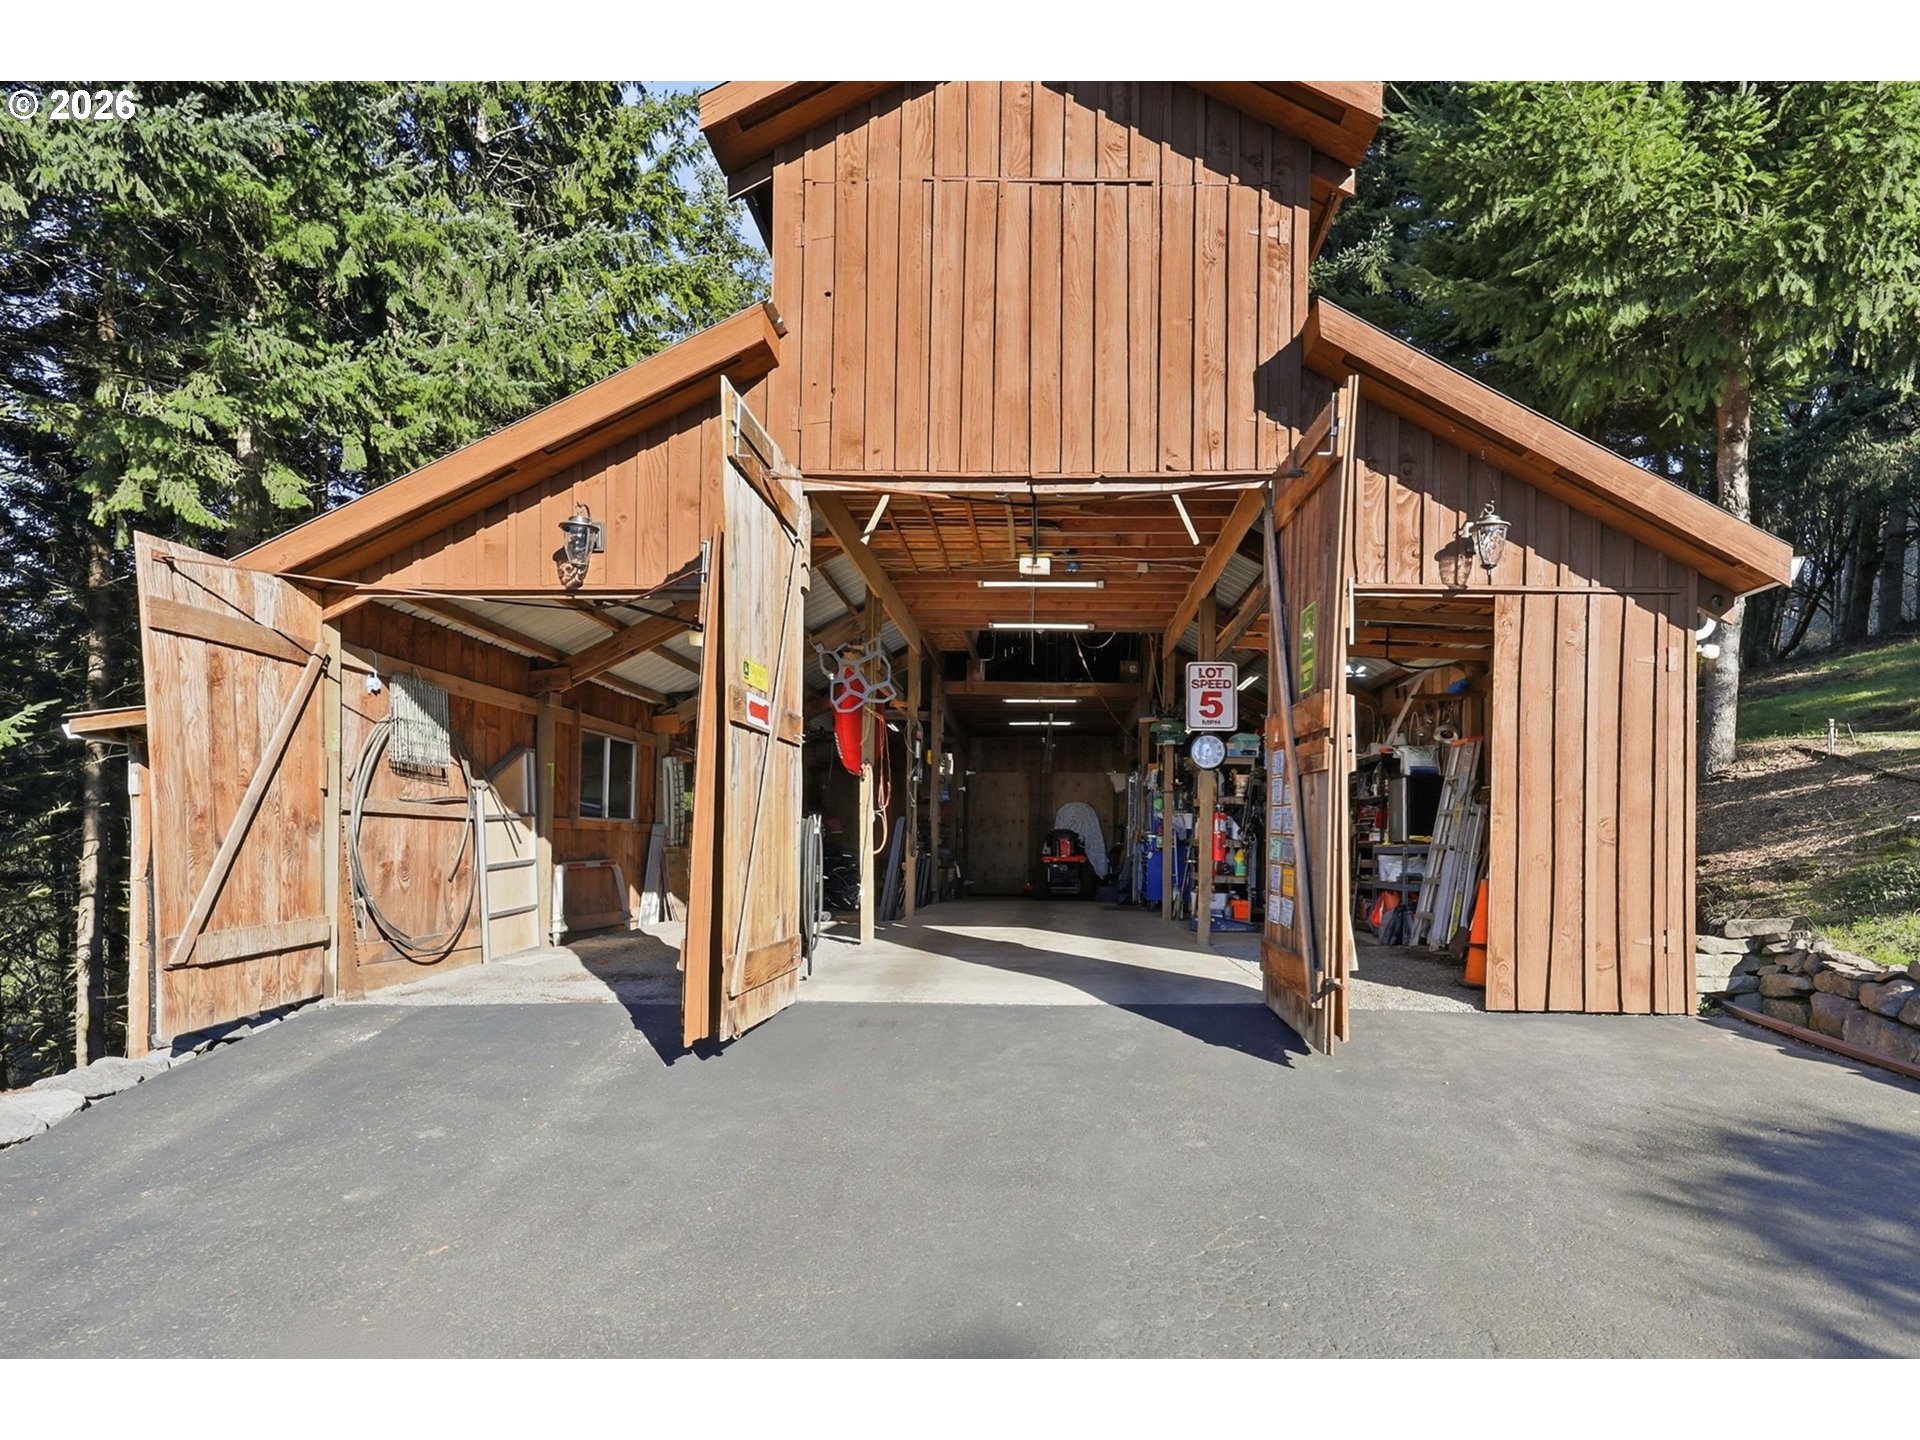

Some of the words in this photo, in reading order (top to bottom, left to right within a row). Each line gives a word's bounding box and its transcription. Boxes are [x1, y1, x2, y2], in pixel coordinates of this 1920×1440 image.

[1198, 667, 1224, 678] LOT
[1191, 679, 1232, 689] SPEED
[1199, 691, 1224, 718] 5
